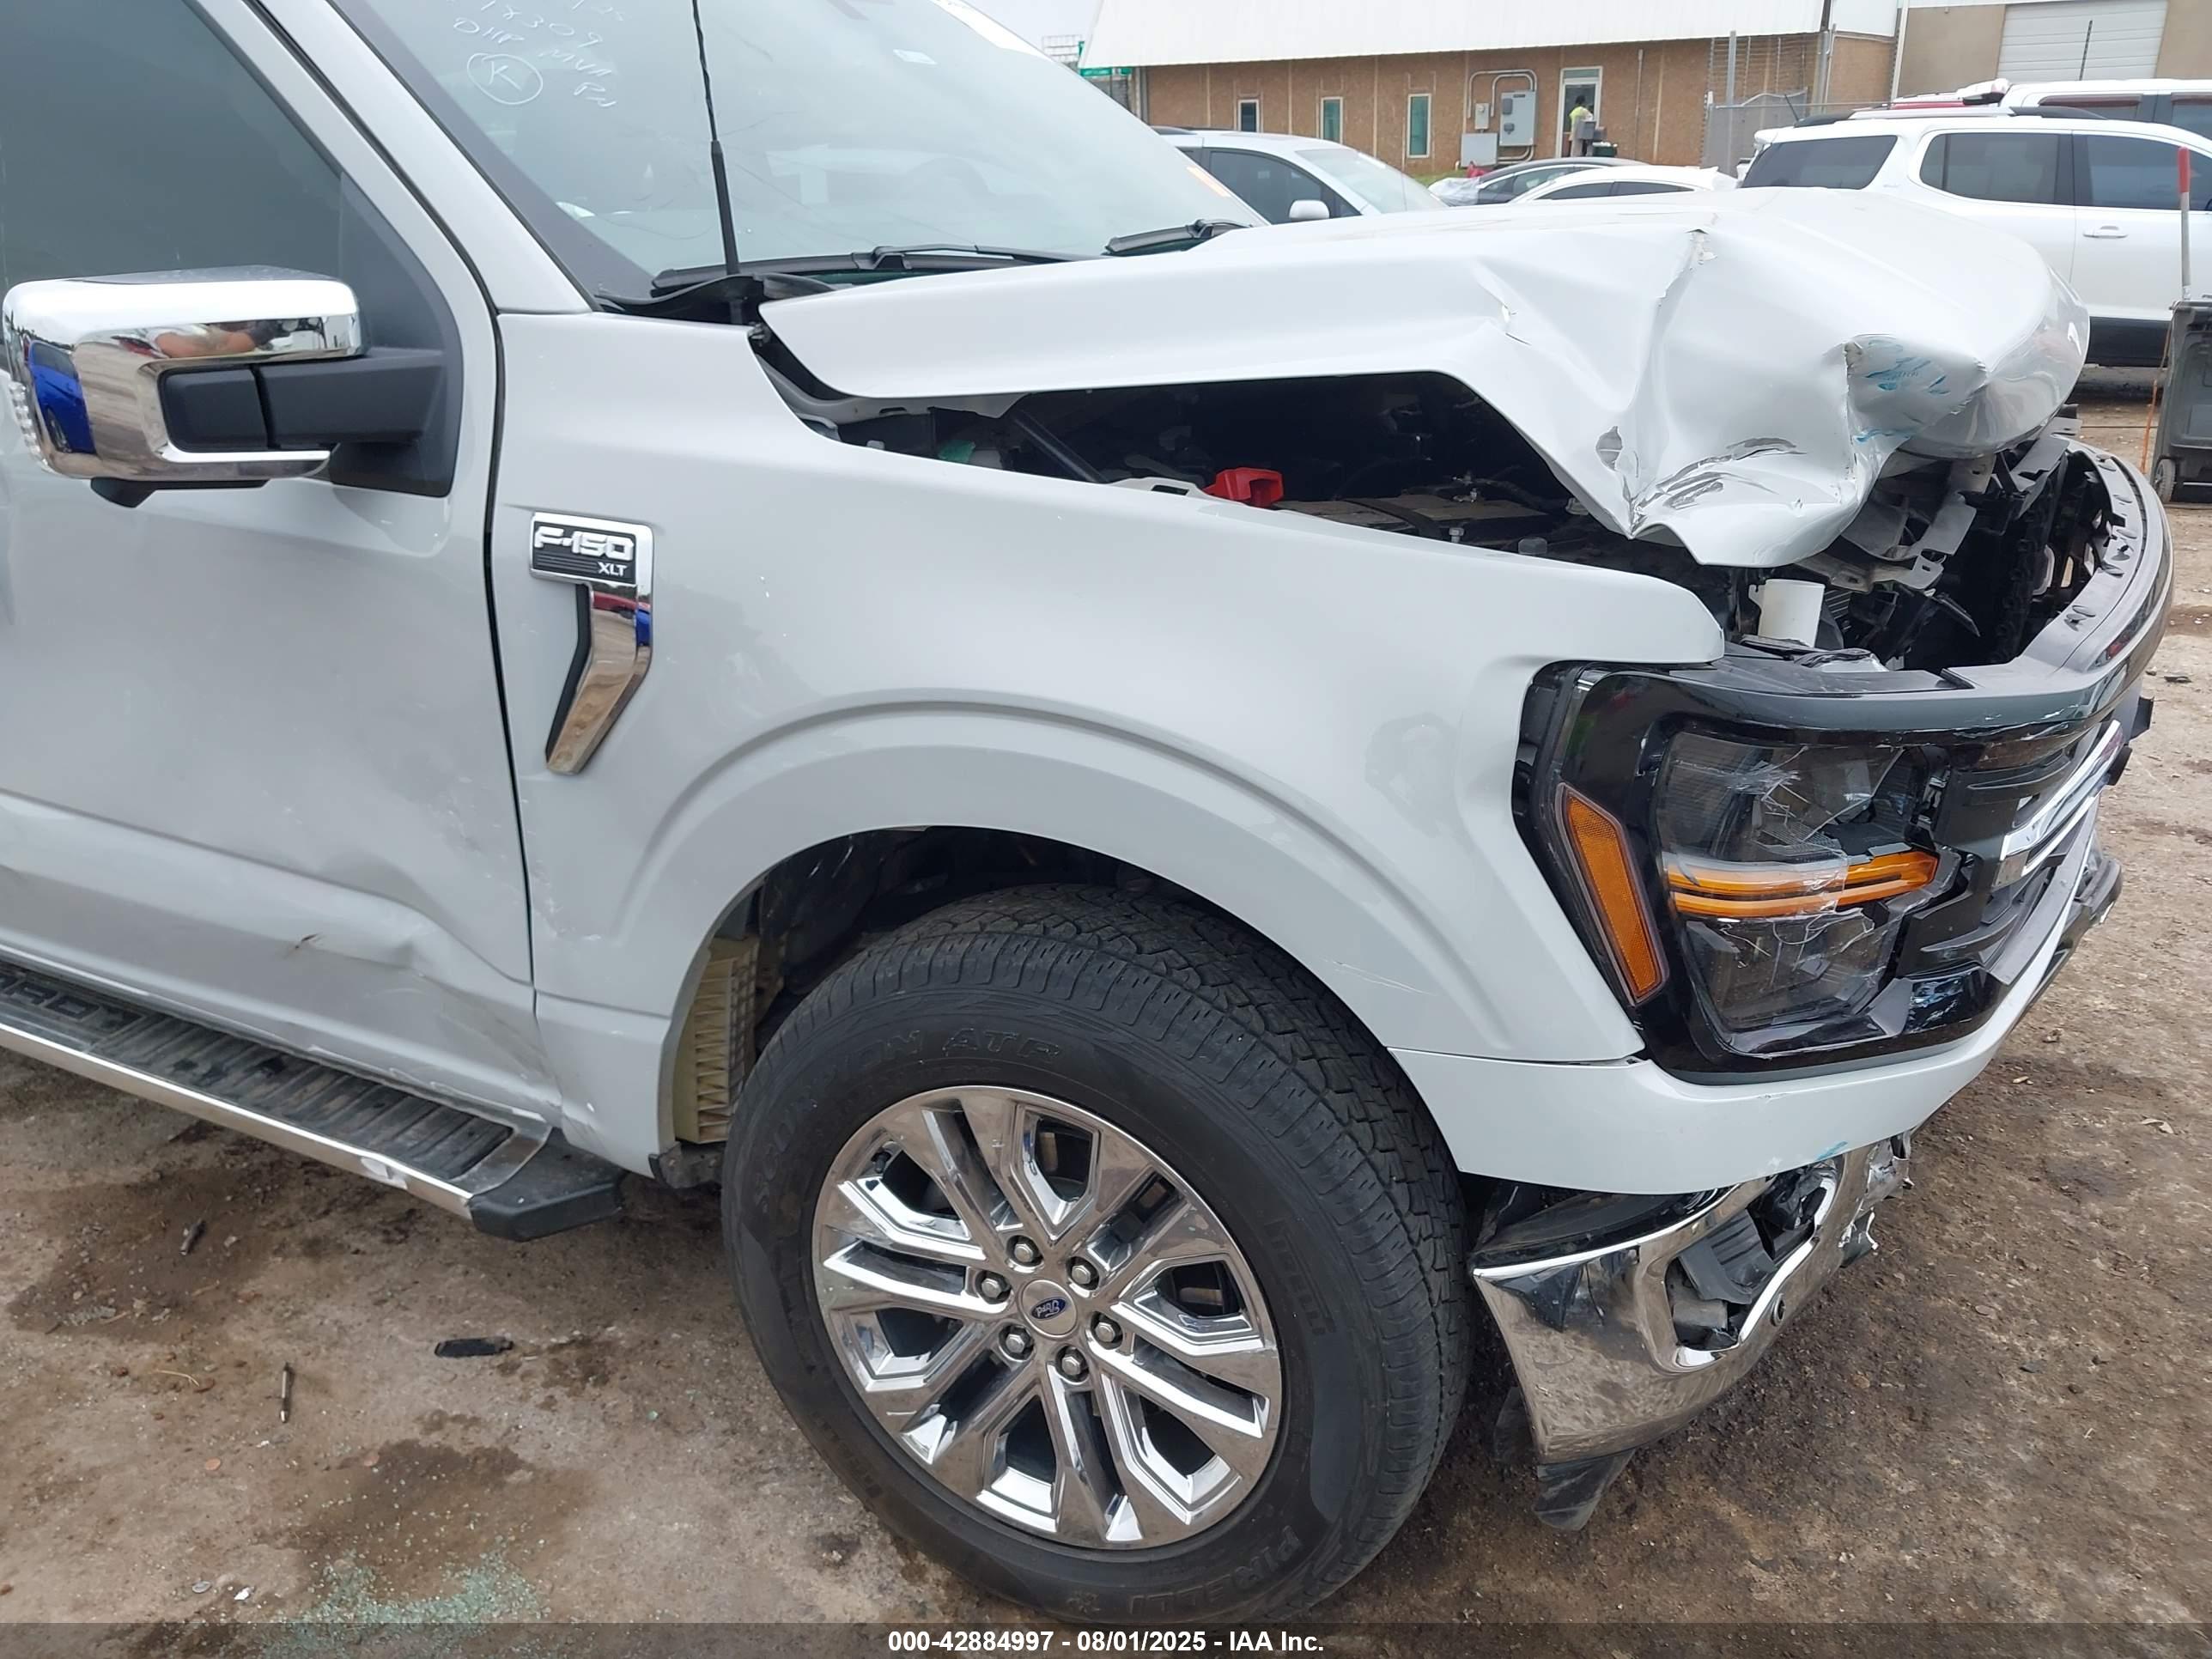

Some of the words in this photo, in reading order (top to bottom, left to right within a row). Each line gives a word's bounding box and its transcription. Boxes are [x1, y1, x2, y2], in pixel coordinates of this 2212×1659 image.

[534, 526, 635, 562] F-150
[598, 561, 628, 577] XLT
[941, 1026, 1061, 1059] ATR
